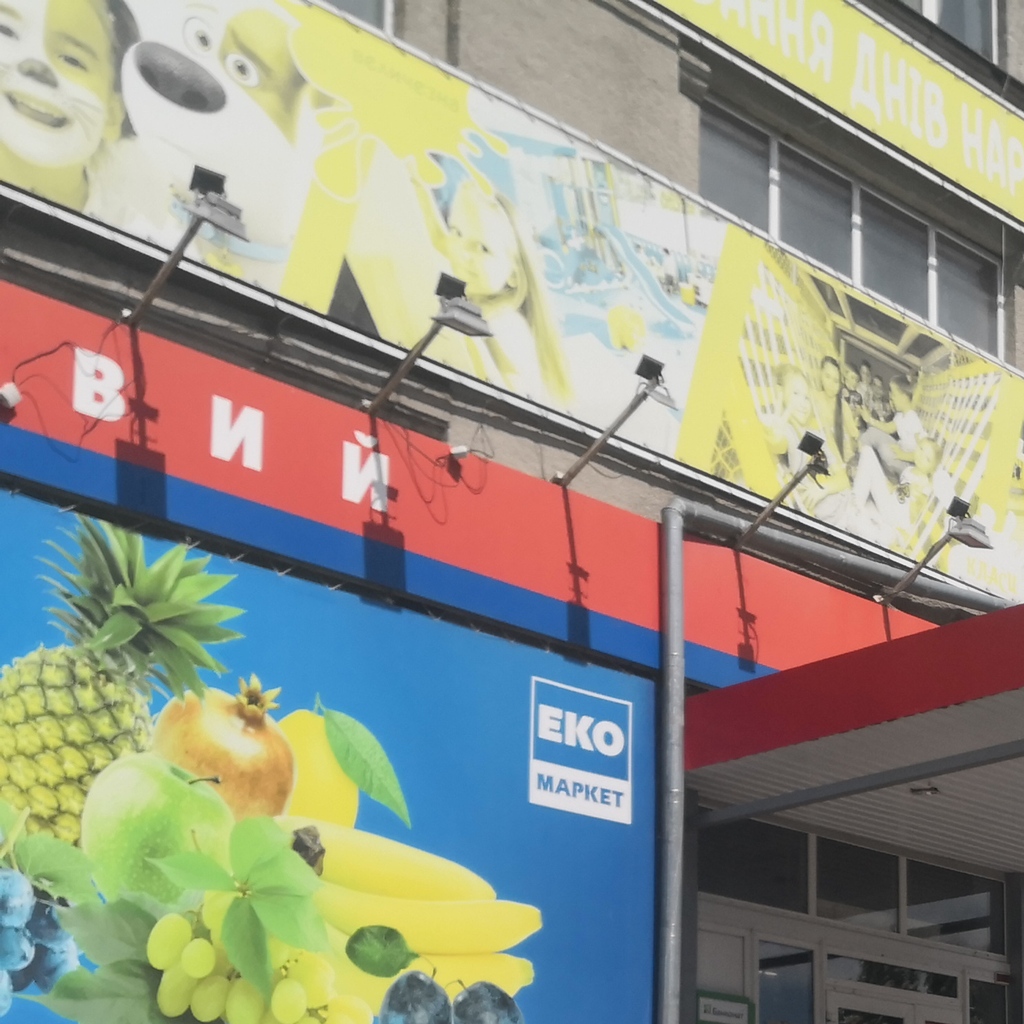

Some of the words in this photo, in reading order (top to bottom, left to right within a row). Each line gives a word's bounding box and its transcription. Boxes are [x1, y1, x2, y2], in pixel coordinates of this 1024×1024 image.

[694, 0, 834, 83] ННЯ
[851, 32, 948, 149] ДНІВ
[538, 703, 625, 757] ЕКО
[537, 773, 624, 808] МАРКЕТ
